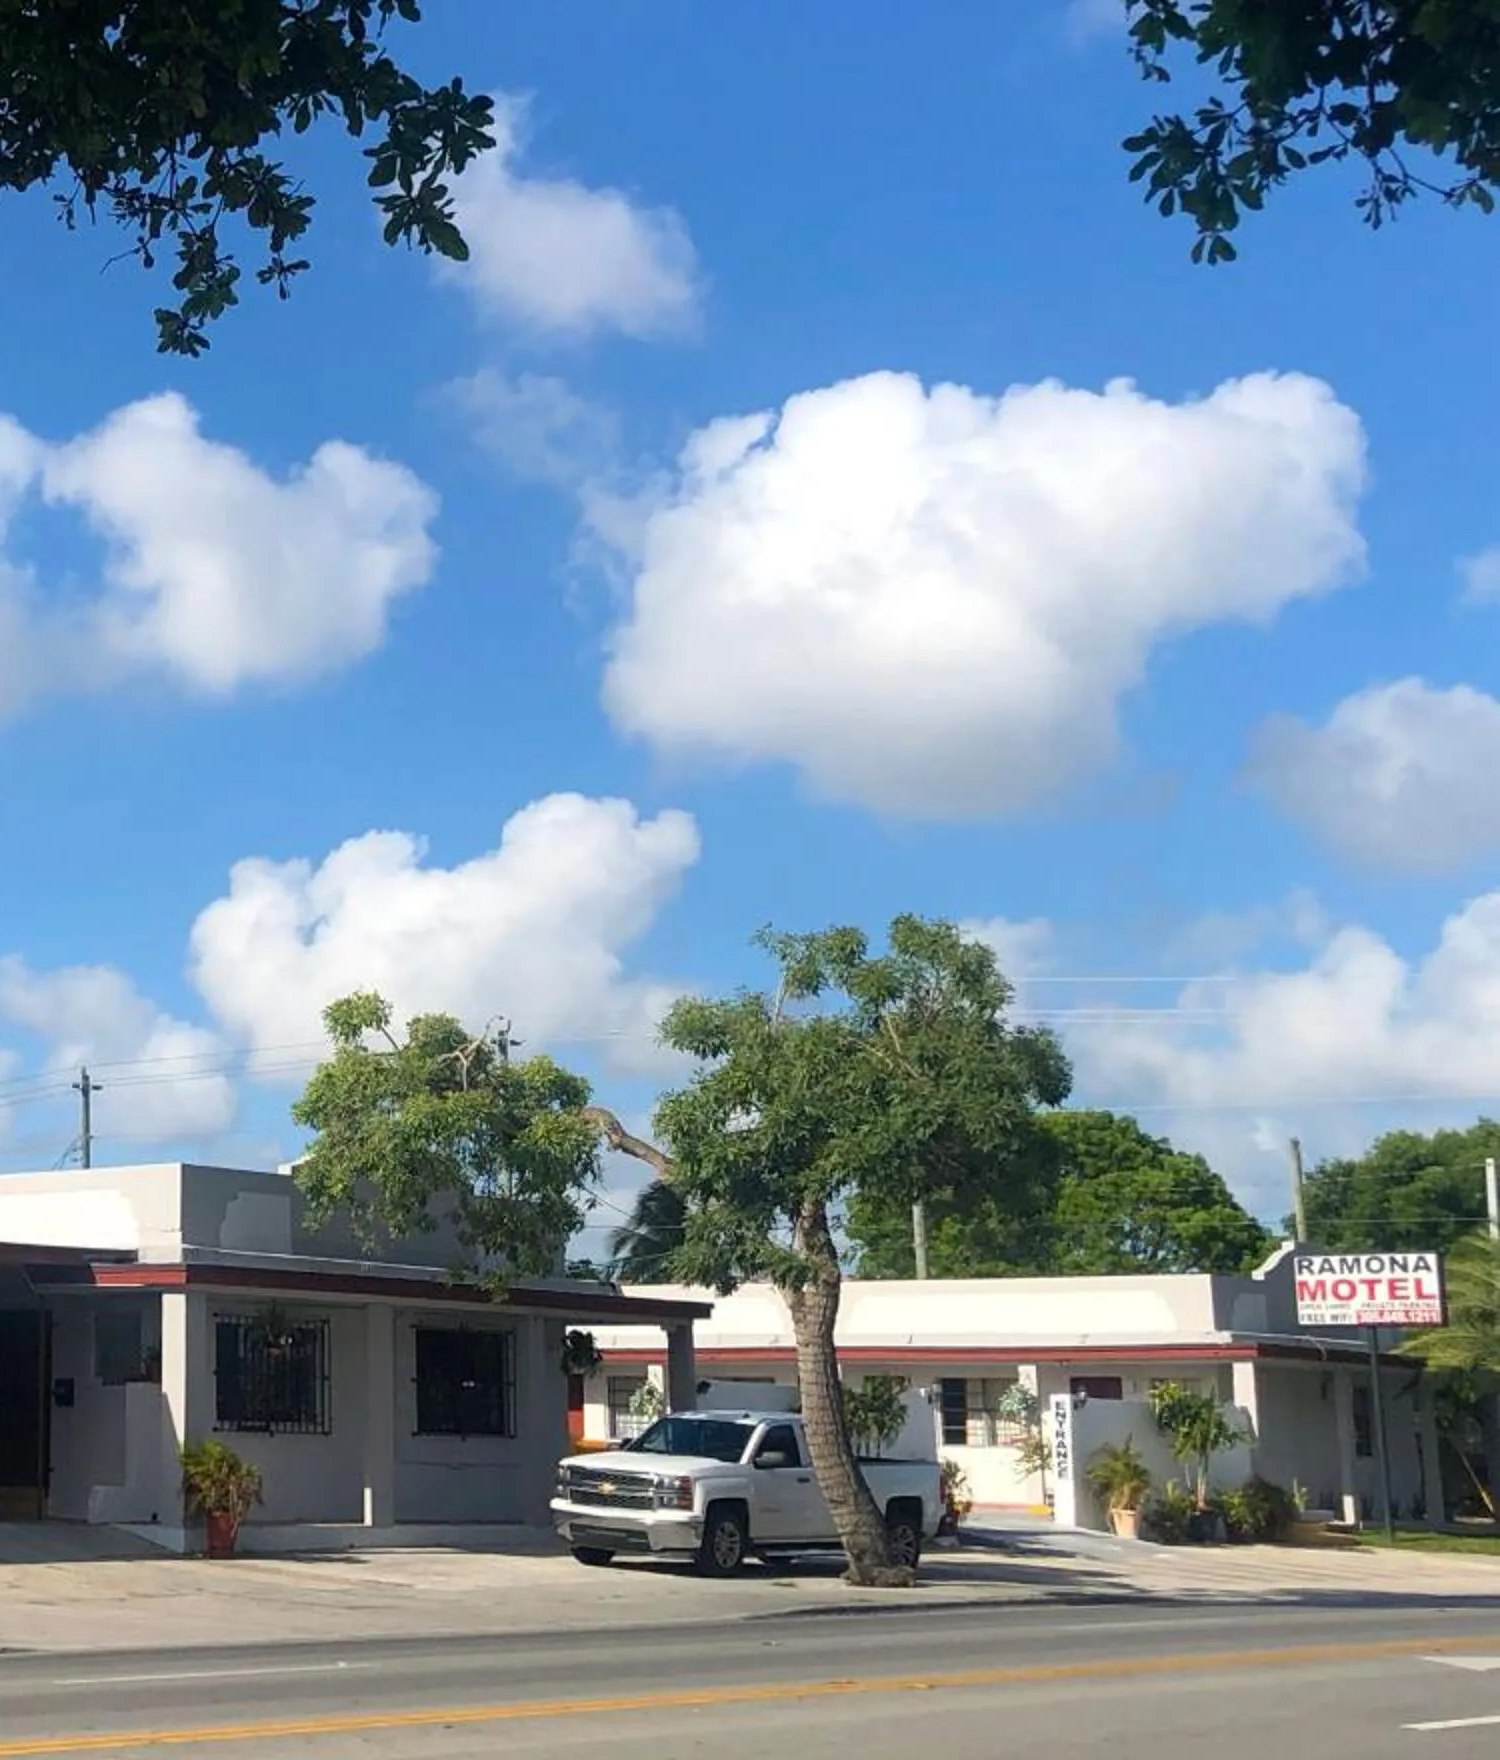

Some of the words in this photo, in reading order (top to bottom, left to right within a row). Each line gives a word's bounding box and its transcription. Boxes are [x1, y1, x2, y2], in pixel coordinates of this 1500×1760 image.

[1298, 1255, 1432, 1275] RAMONA
[1297, 1278, 1436, 1301] MOTEL
[1055, 1401, 1069, 1480] ENTRANCE
